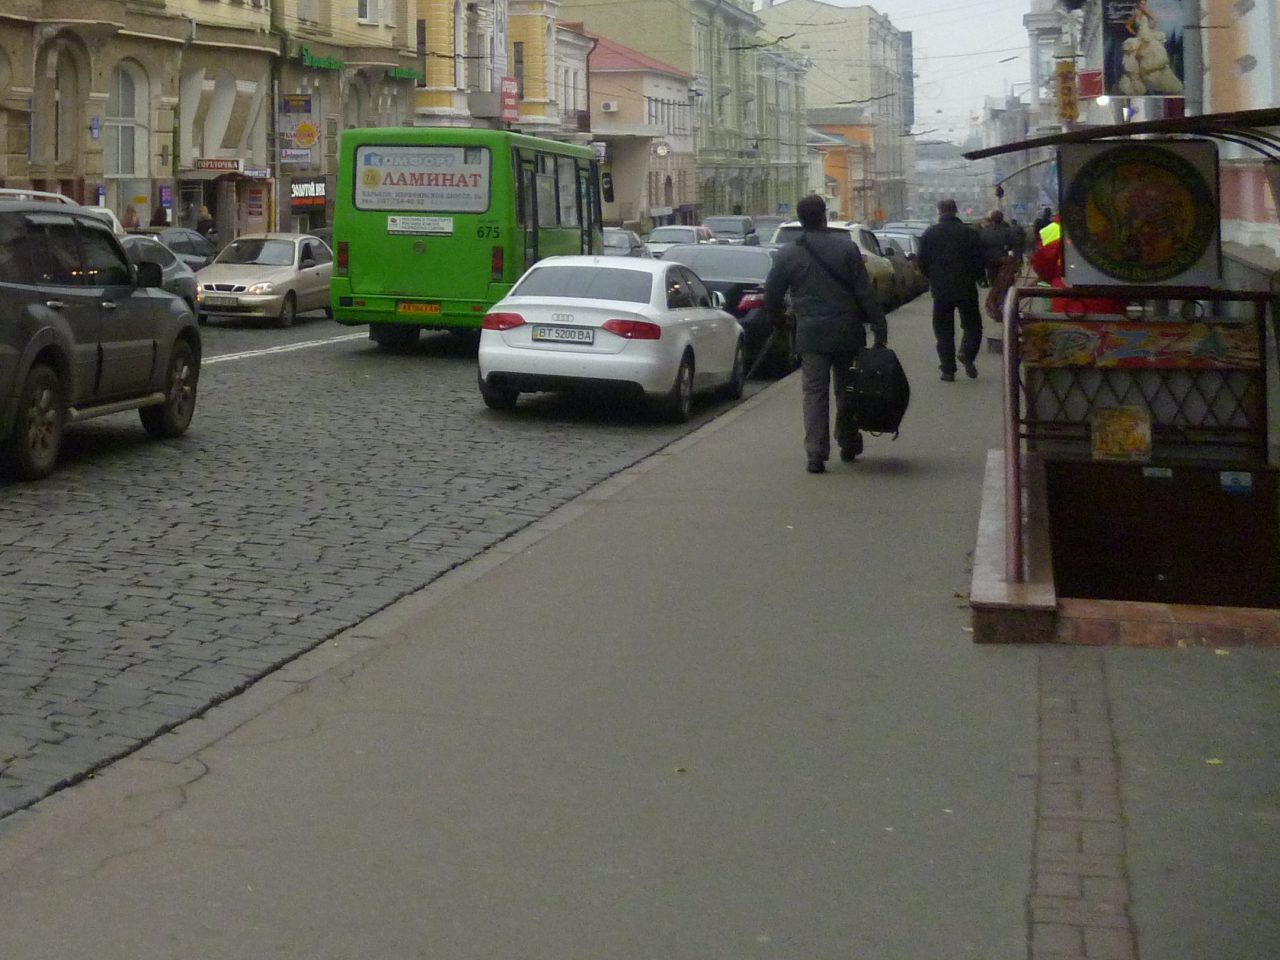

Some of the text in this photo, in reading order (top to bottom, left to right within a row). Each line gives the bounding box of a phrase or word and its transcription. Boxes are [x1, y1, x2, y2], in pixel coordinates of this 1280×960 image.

[382, 171, 481, 188] ЛАМИНАТ
[477, 226, 500, 238] 675
[539, 328, 591, 340] BT 5200 BA
